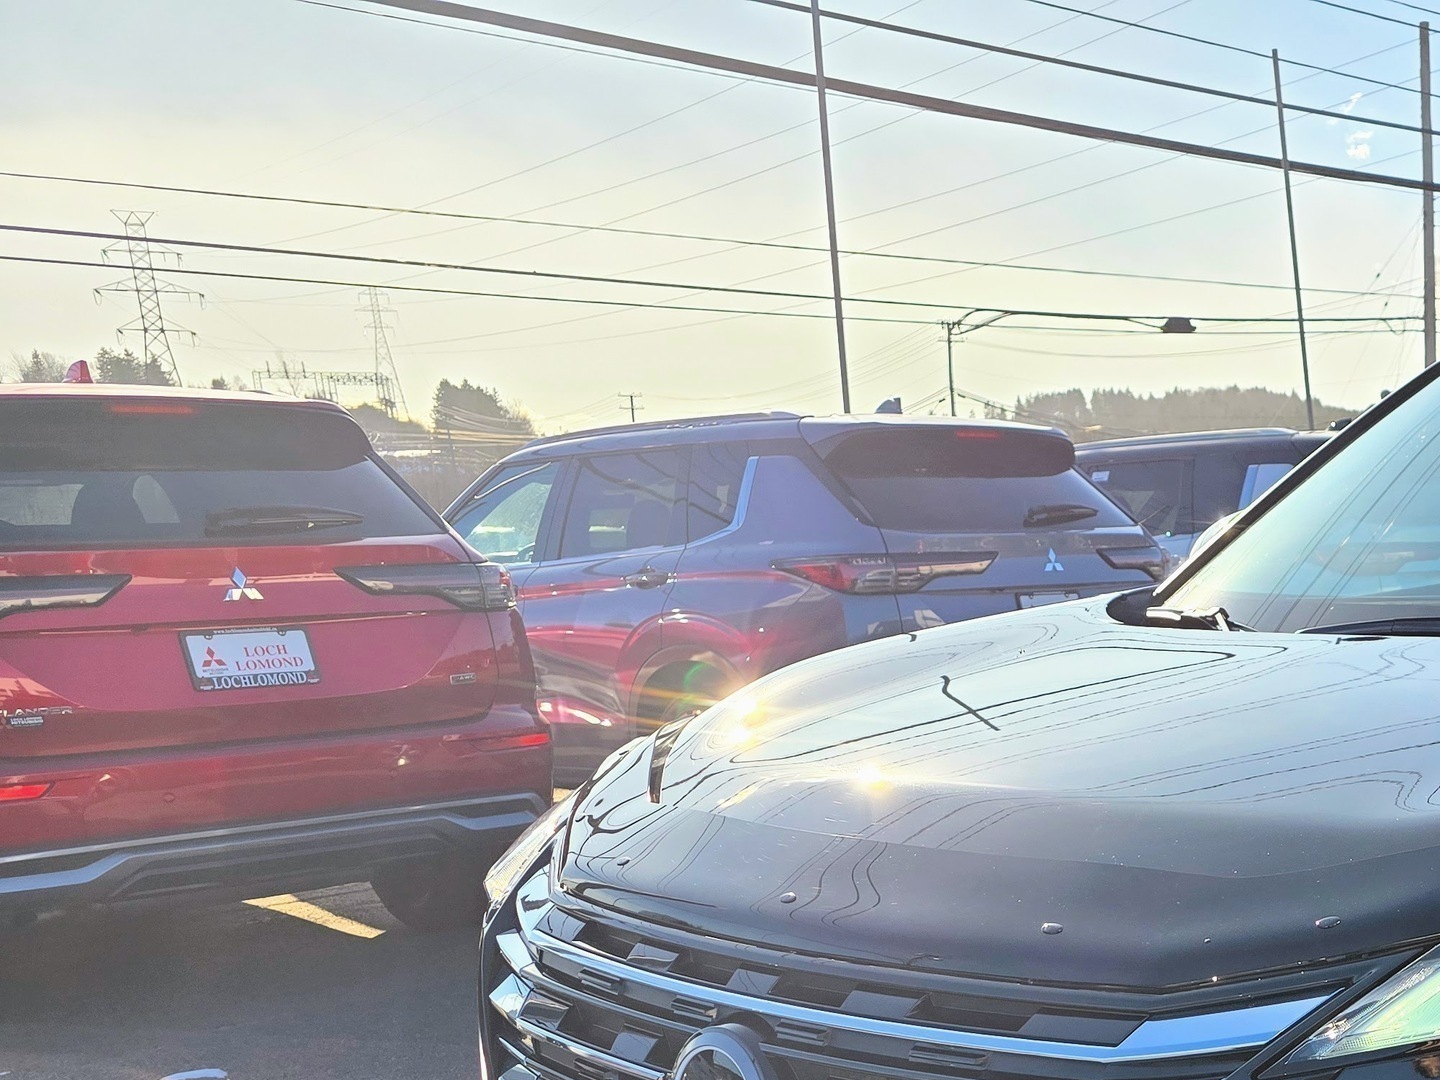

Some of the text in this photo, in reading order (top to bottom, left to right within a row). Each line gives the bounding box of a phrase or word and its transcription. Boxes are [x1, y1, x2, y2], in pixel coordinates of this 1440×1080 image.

[243, 644, 288, 658] LOCH
[235, 656, 304, 672] LOMOND
[211, 671, 308, 690] LOCHLOMOND
[0, 705, 74, 718] LANDER
